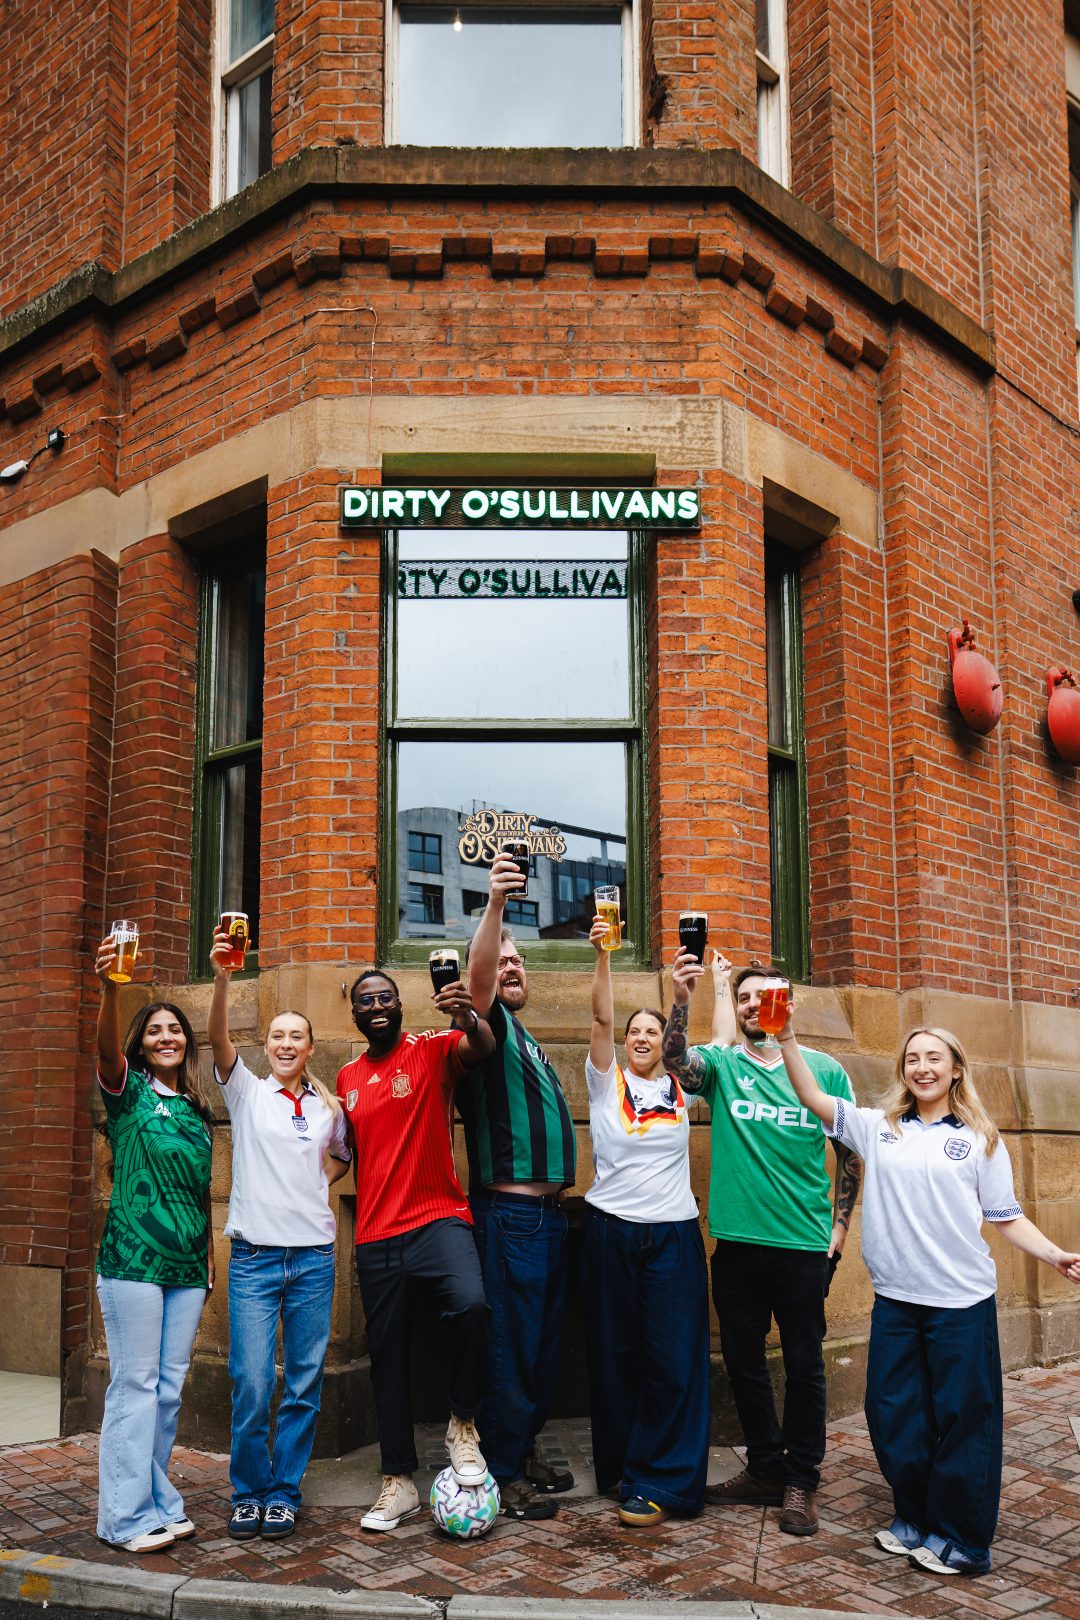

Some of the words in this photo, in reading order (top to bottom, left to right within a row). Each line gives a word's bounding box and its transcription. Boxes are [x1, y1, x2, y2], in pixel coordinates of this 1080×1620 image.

[343, 489, 451, 519] DIRTY
[462, 490, 699, 520] O'SULLIVANS
[458, 568, 628, 595] O'SULLIVA
[475, 809, 537, 837] DIRTY
[730, 1099, 818, 1130] OPEL
